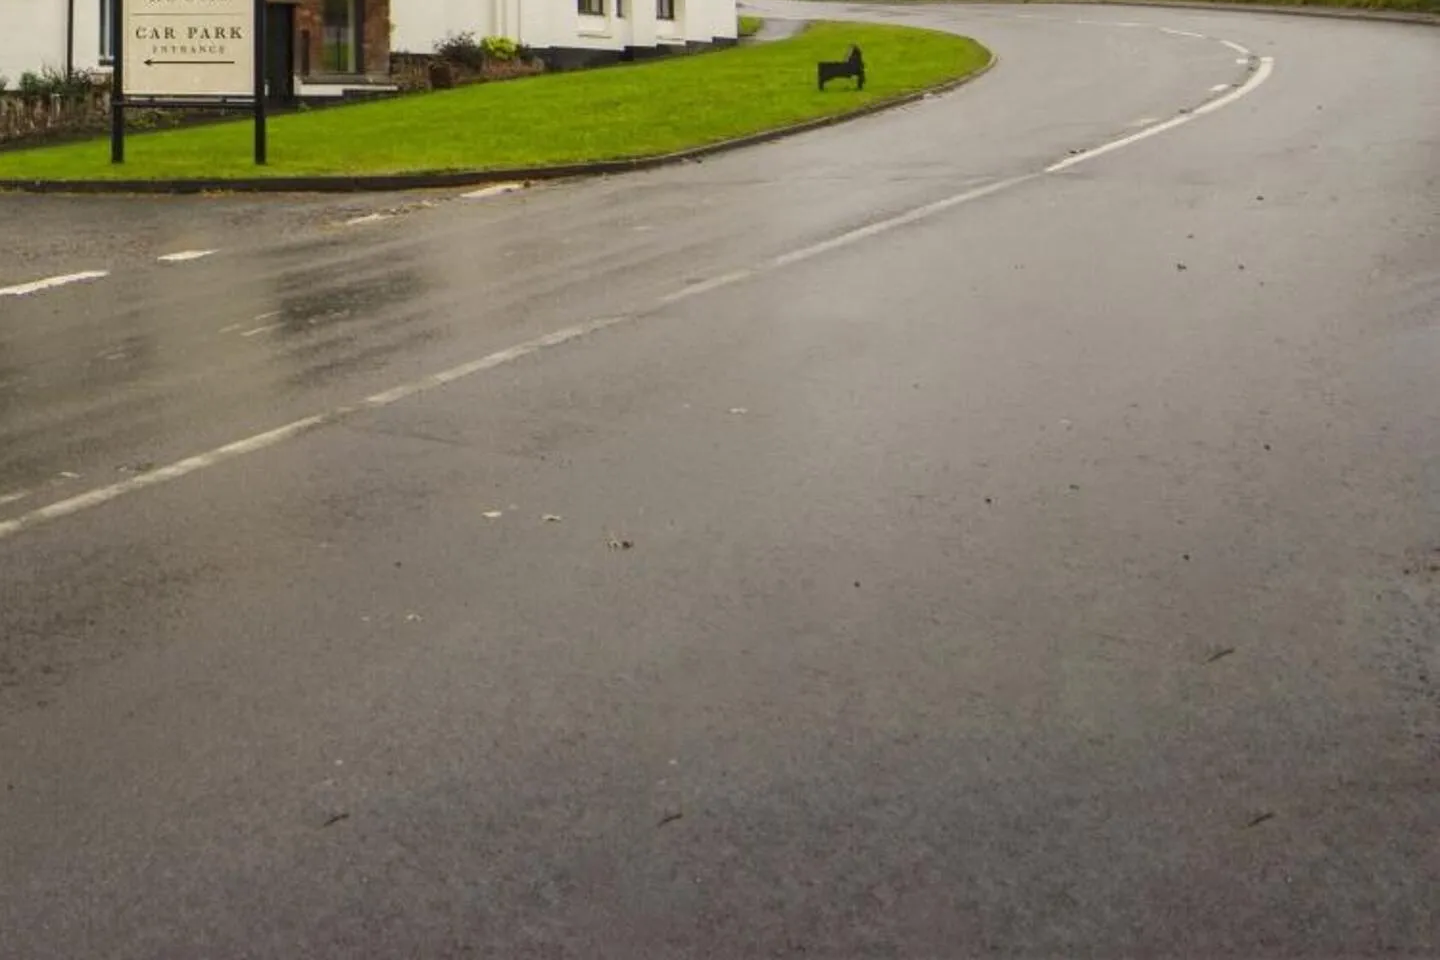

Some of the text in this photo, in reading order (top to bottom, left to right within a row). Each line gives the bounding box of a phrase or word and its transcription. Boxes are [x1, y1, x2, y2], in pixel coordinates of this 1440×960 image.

[135, 26, 242, 40] CAR PARK
[152, 45, 225, 54] ENTRANCE
